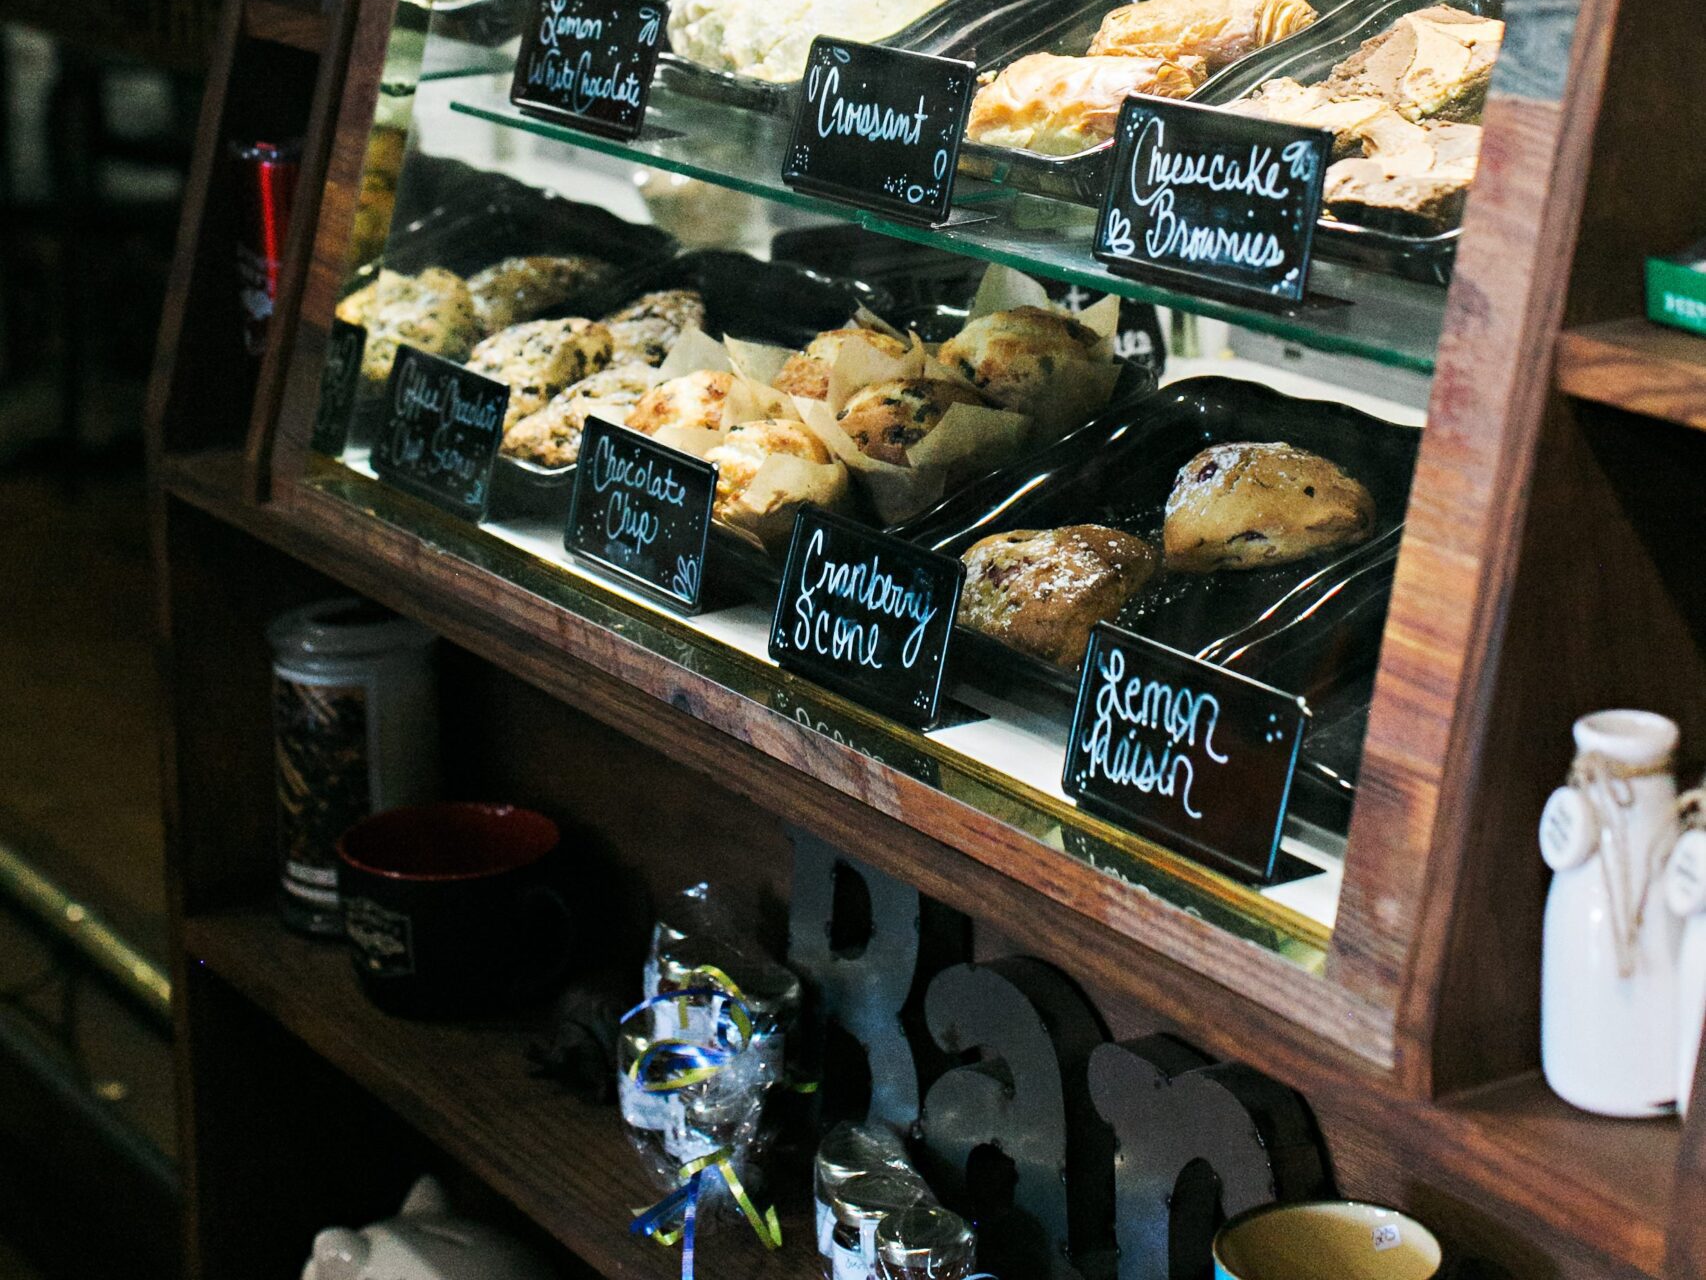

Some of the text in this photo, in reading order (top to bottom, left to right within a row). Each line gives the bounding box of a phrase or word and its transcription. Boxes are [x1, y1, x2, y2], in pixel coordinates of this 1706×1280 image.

[528, 48, 641, 114] White Chocolate
[817, 66, 929, 145] Croissant
[1145, 188, 1285, 268] Brownies
[593, 435, 686, 507] Chocolate
[606, 490, 659, 555] Chip
[794, 592, 883, 669] Scone
[801, 528, 938, 668] Cranberry
[1097, 648, 1229, 764] Lemon
[1081, 718, 1203, 819] Raisin
